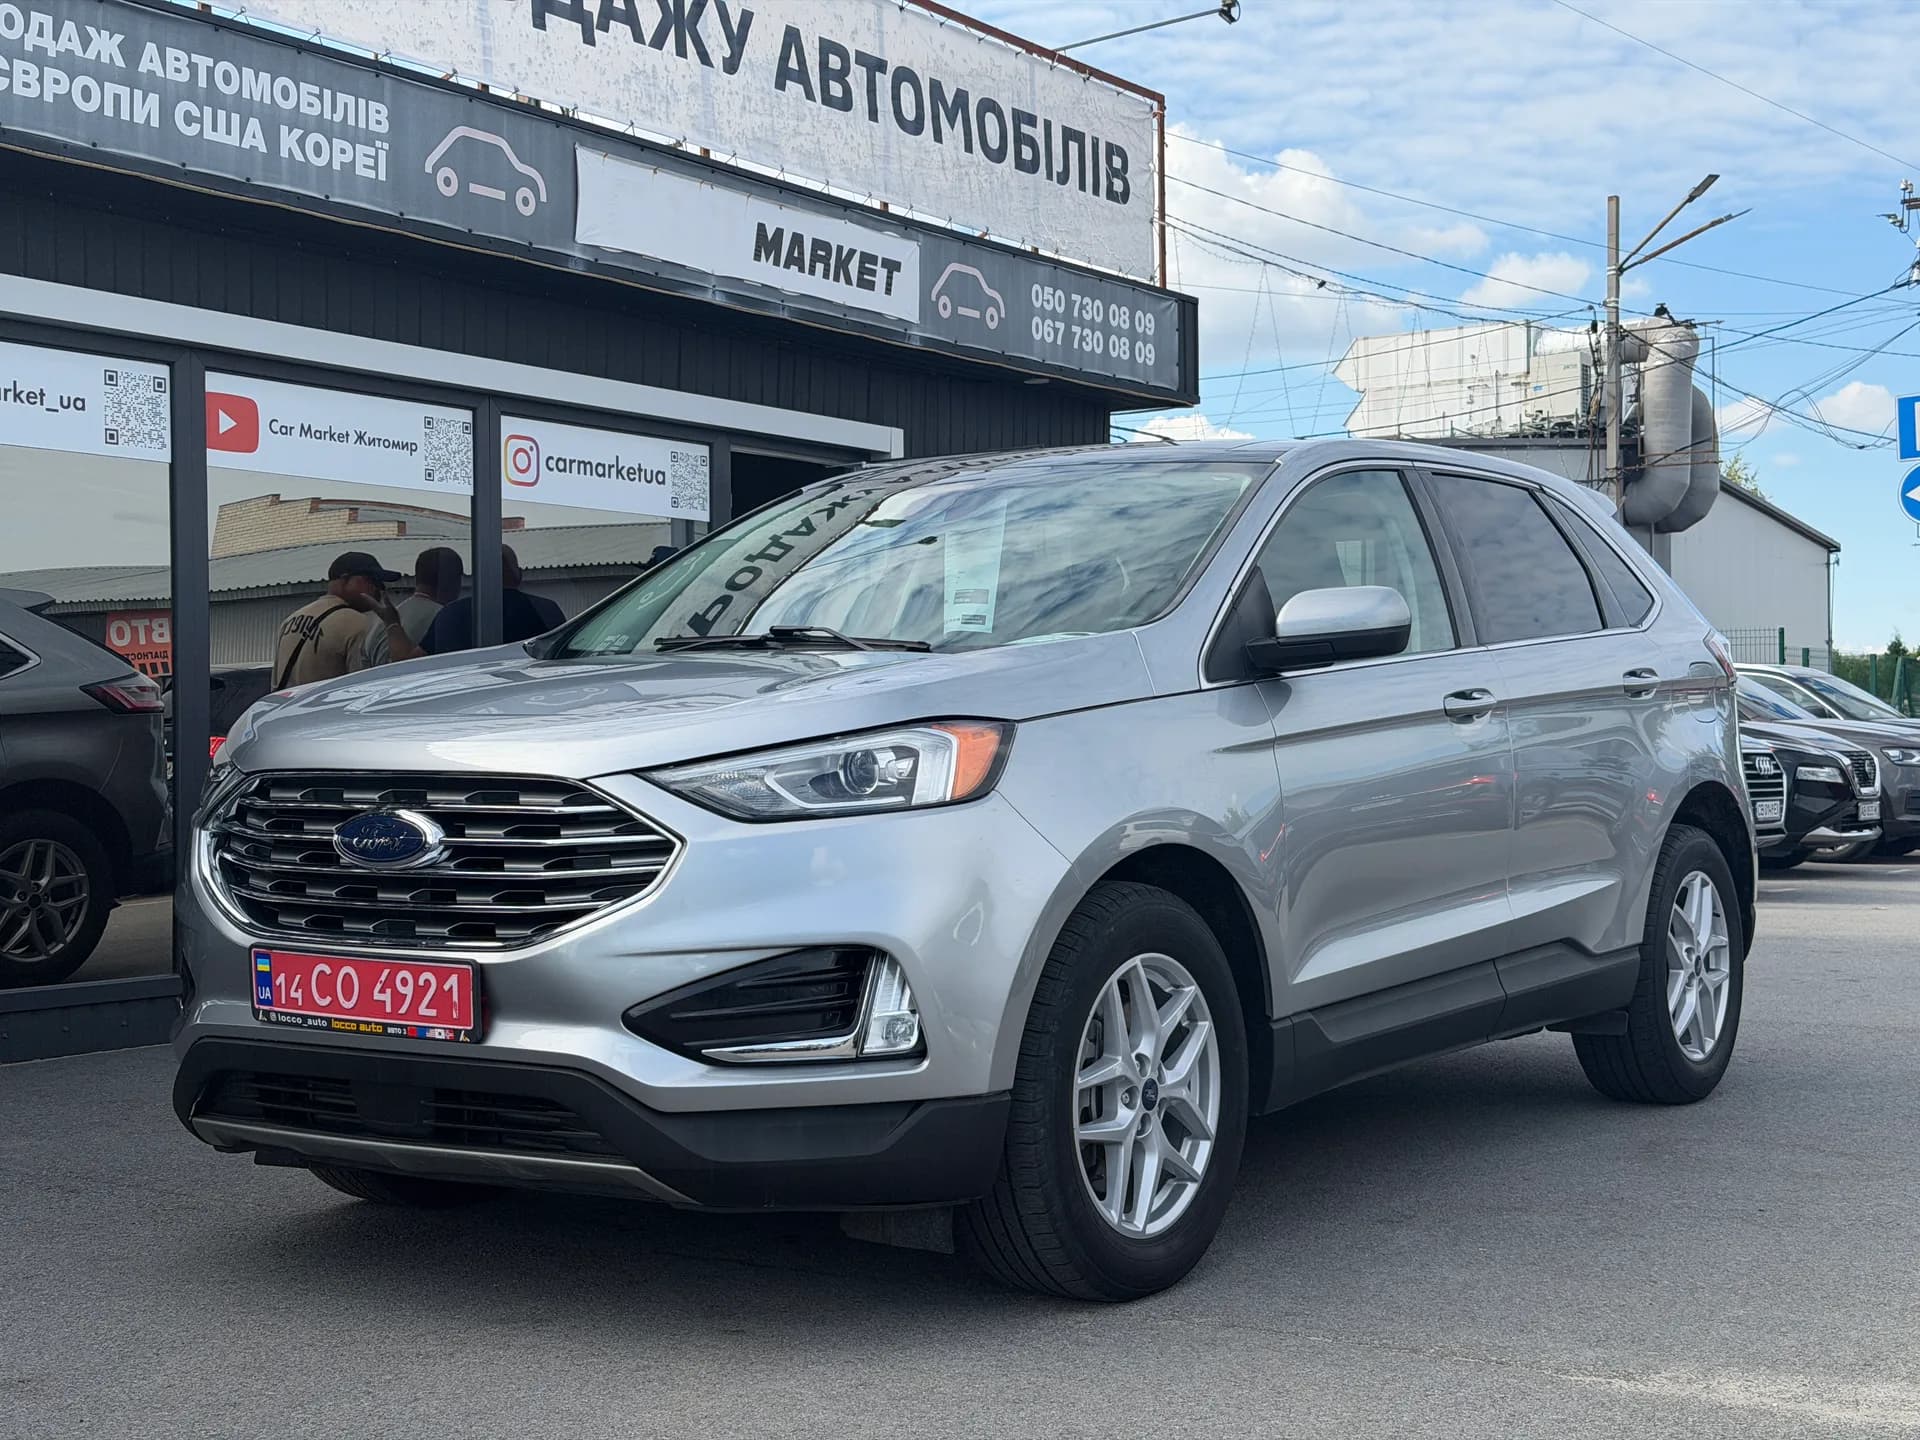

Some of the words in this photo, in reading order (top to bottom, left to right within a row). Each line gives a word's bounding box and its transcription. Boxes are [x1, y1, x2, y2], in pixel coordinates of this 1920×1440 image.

[0, 3, 126, 68] ОДАЖ
[137, 41, 390, 134] АВТОМОБІЛІВ
[774, 24, 1131, 205] АВТОМОБІЛІВ
[174, 100, 268, 153] США
[279, 124, 390, 182] КОРЕЇ
[753, 222, 902, 296] MARKET
[1031, 283, 1066, 314] 050
[1071, 293, 1104, 323] 730
[1108, 303, 1130, 330] 08
[1134, 310, 1155, 336] 09
[1031, 316, 1065, 345] 067
[1071, 325, 1104, 354] 730
[1108, 334, 1130, 360] 08
[1134, 340, 1156, 366] 09
[0, 380, 86, 412] rket_ua
[268, 419, 295, 437] Car
[299, 423, 350, 444] Market
[353, 429, 418, 456] Житомир
[545, 455, 667, 486] carmarketua
[258, 986, 272, 1001] UA
[373, 968, 460, 1020] 4921
[331, 1018, 357, 1031] locco
[360, 1023, 383, 1034] auto
